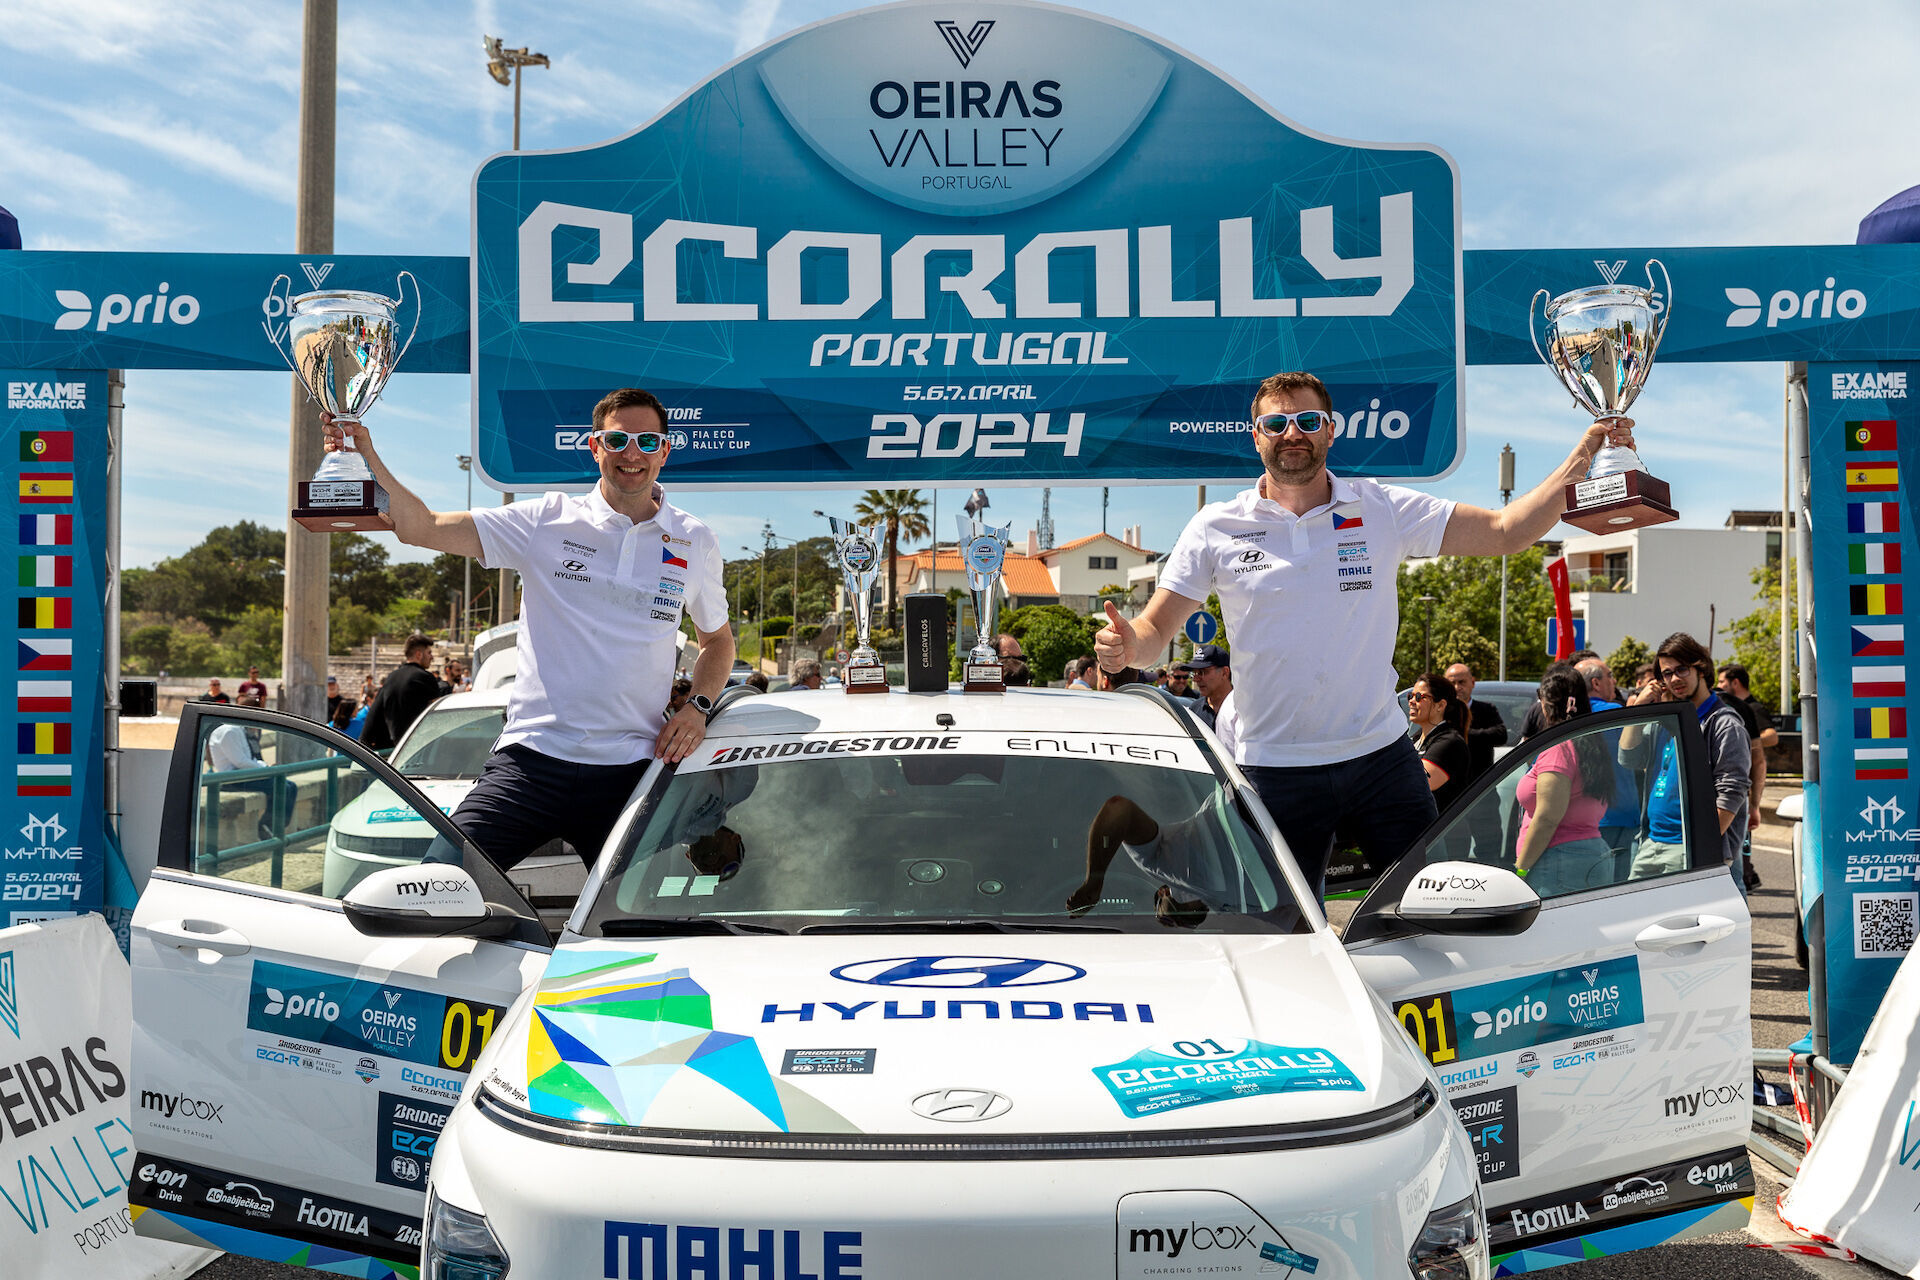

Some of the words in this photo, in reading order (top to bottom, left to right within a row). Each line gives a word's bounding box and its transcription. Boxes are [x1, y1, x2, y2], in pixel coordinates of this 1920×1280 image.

[870, 80, 1063, 119] OEIRAS
[869, 128, 1063, 168] VALLEY
[922, 175, 1012, 190] PORTUGAL
[97, 282, 200, 331] prio
[1767, 277, 1867, 327] prio
[810, 332, 1128, 366] PORTUGAL
[8, 382, 86, 400] EXAME
[1832, 372, 1907, 390] EXAME
[693, 430, 710, 439] FIA
[713, 430, 735, 438] ECO
[693, 441, 727, 450] RALLY
[729, 441, 751, 450] CUP
[866, 412, 1086, 458] 2024
[554, 571, 592, 583] HYUNDAI
[1234, 564, 1272, 575] HYUNDAI
[1338, 566, 1372, 576] MAHLE
[654, 596, 682, 609] MAHLE
[921, 618, 929, 668] CARCAVELOS
[708, 735, 961, 766] BRIDGESTONE
[1007, 738, 1180, 763] ENLITEN
[1846, 828, 1920, 842] MYTIME
[5, 847, 82, 859] MYTIME
[1418, 875, 1487, 892] mybox
[1845, 865, 1920, 883] 2024
[2, 884, 81, 901] 2024
[396, 878, 469, 896] mybox
[285, 991, 340, 1022] prio
[1568, 985, 1619, 1008] OEIRAS
[362, 1008, 417, 1031] OEIRAS
[761, 1000, 1154, 1023] HYUNDAI
[1495, 995, 1548, 1036] prio
[1569, 1001, 1620, 1024] VALLEY
[360, 1024, 416, 1048] VALLEY
[441, 1001, 494, 1069] 01
[1397, 998, 1456, 1064] 01
[1573, 1034, 1615, 1050] BRIDGESTONE
[278, 1039, 322, 1056] BRIDGESTONE
[1172, 1038, 1234, 1057] 01
[1329, 1078, 1353, 1086] prio
[141, 1090, 224, 1124] mybox
[1457, 1098, 1504, 1121] ESTONE
[1664, 1082, 1745, 1118] mybox
[393, 1103, 448, 1127] BRIDGE
[1675, 1121, 1706, 1133] CHARGING
[1708, 1115, 1737, 1125] STATIONS
[149, 1121, 181, 1133] CHARGING
[183, 1129, 213, 1140] STATIONS
[1484, 1161, 1506, 1174] CUP
[159, 1189, 183, 1203] Drive
[1715, 1181, 1738, 1194] Drive
[297, 1198, 370, 1237] FLOTILA
[1511, 1201, 1590, 1236] FLOTILA
[73, 1206, 135, 1256] PORTUG
[1130, 1221, 1256, 1258] mybox
[604, 1220, 862, 1280] MAHLE
[1143, 1267, 1192, 1275] CHARGING
[1197, 1265, 1243, 1273] STATIONS
